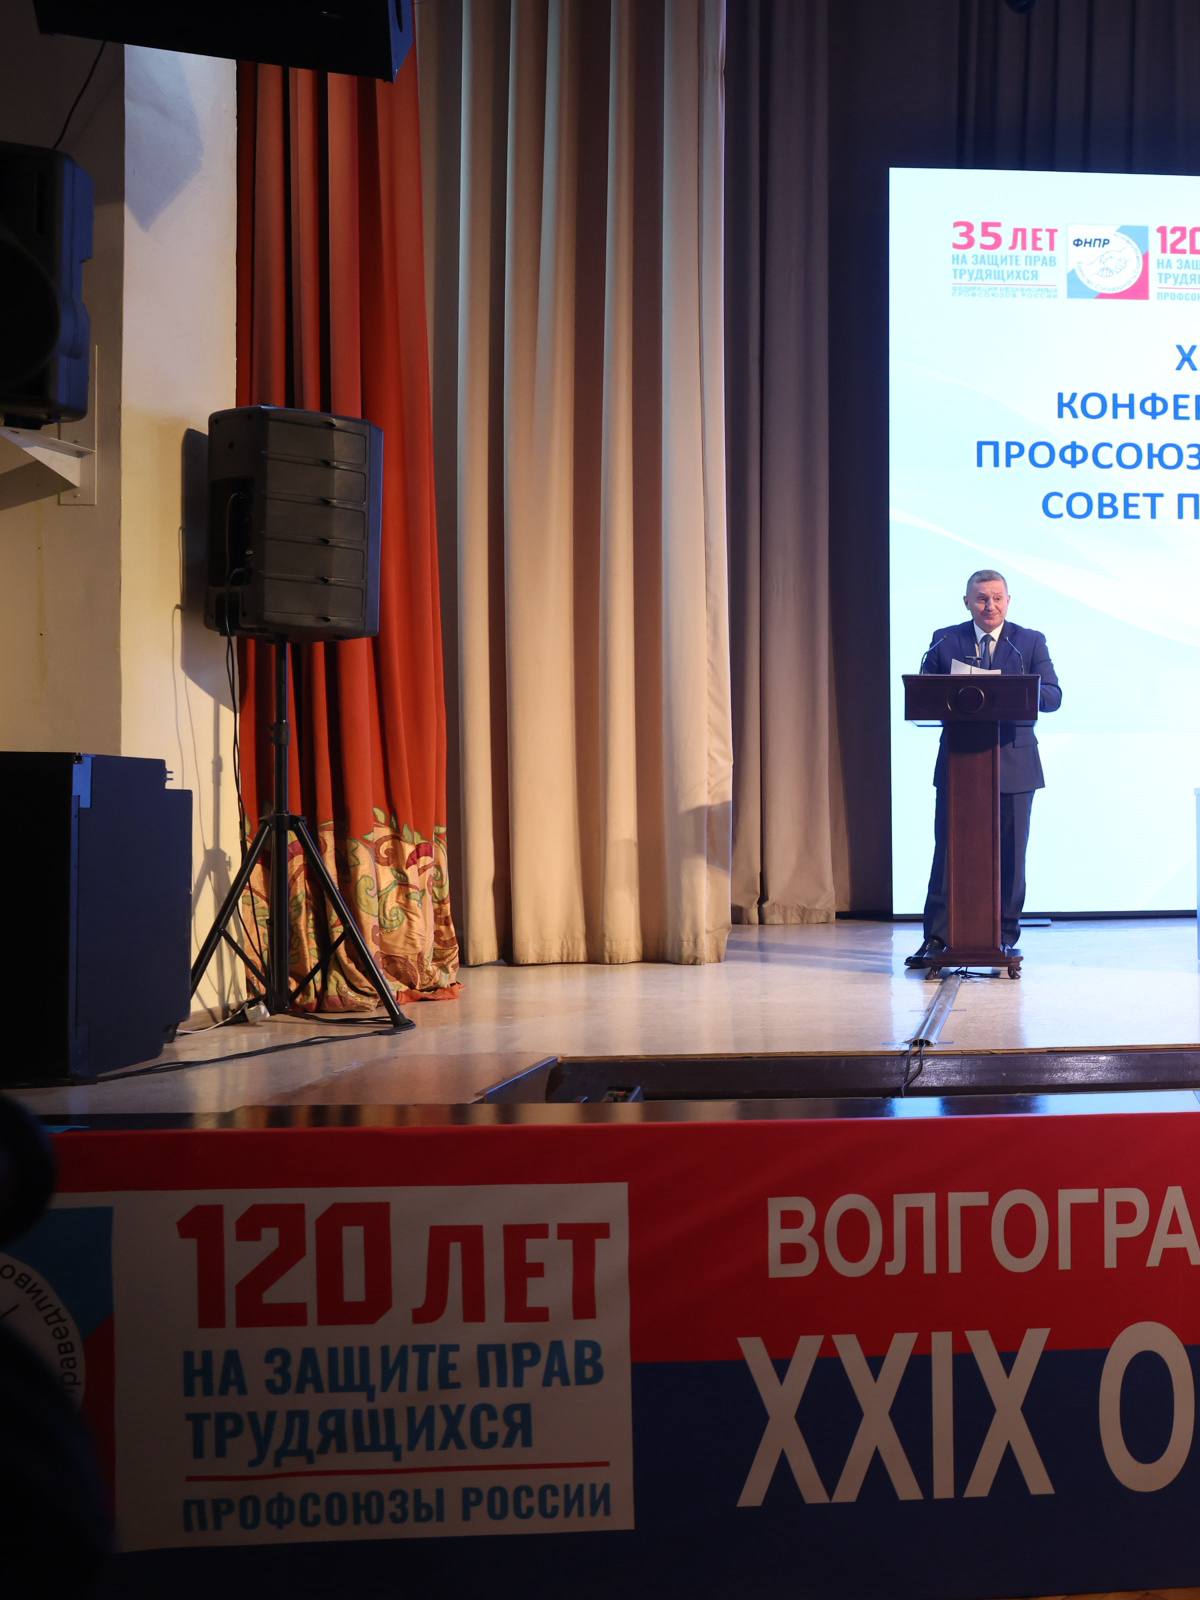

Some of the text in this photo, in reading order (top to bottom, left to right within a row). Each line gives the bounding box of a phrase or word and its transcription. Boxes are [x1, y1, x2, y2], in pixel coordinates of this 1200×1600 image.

[952, 221, 1058, 252] 35 ЛЕТ
[1072, 237, 1110, 249] ФНПР
[952, 254, 1057, 269] НА ЗАЩИТЕ ПРАВ
[952, 268, 1038, 283] ТРУДЯЩИХСЯ
[1157, 259, 1173, 270] НА
[1041, 491, 1164, 520] СОВЕТ
[176, 1202, 610, 1329] 120 ЛЕТ
[182, 1339, 604, 1402] НА ЗАЩИТЕ ПРАВ
[736, 1327, 1056, 1508] XXIX
[185, 1402, 533, 1468] ТРУДЯЩИХСЯ
[182, 1482, 612, 1533] ПРОФСОЮЗЫ РОССИИ
